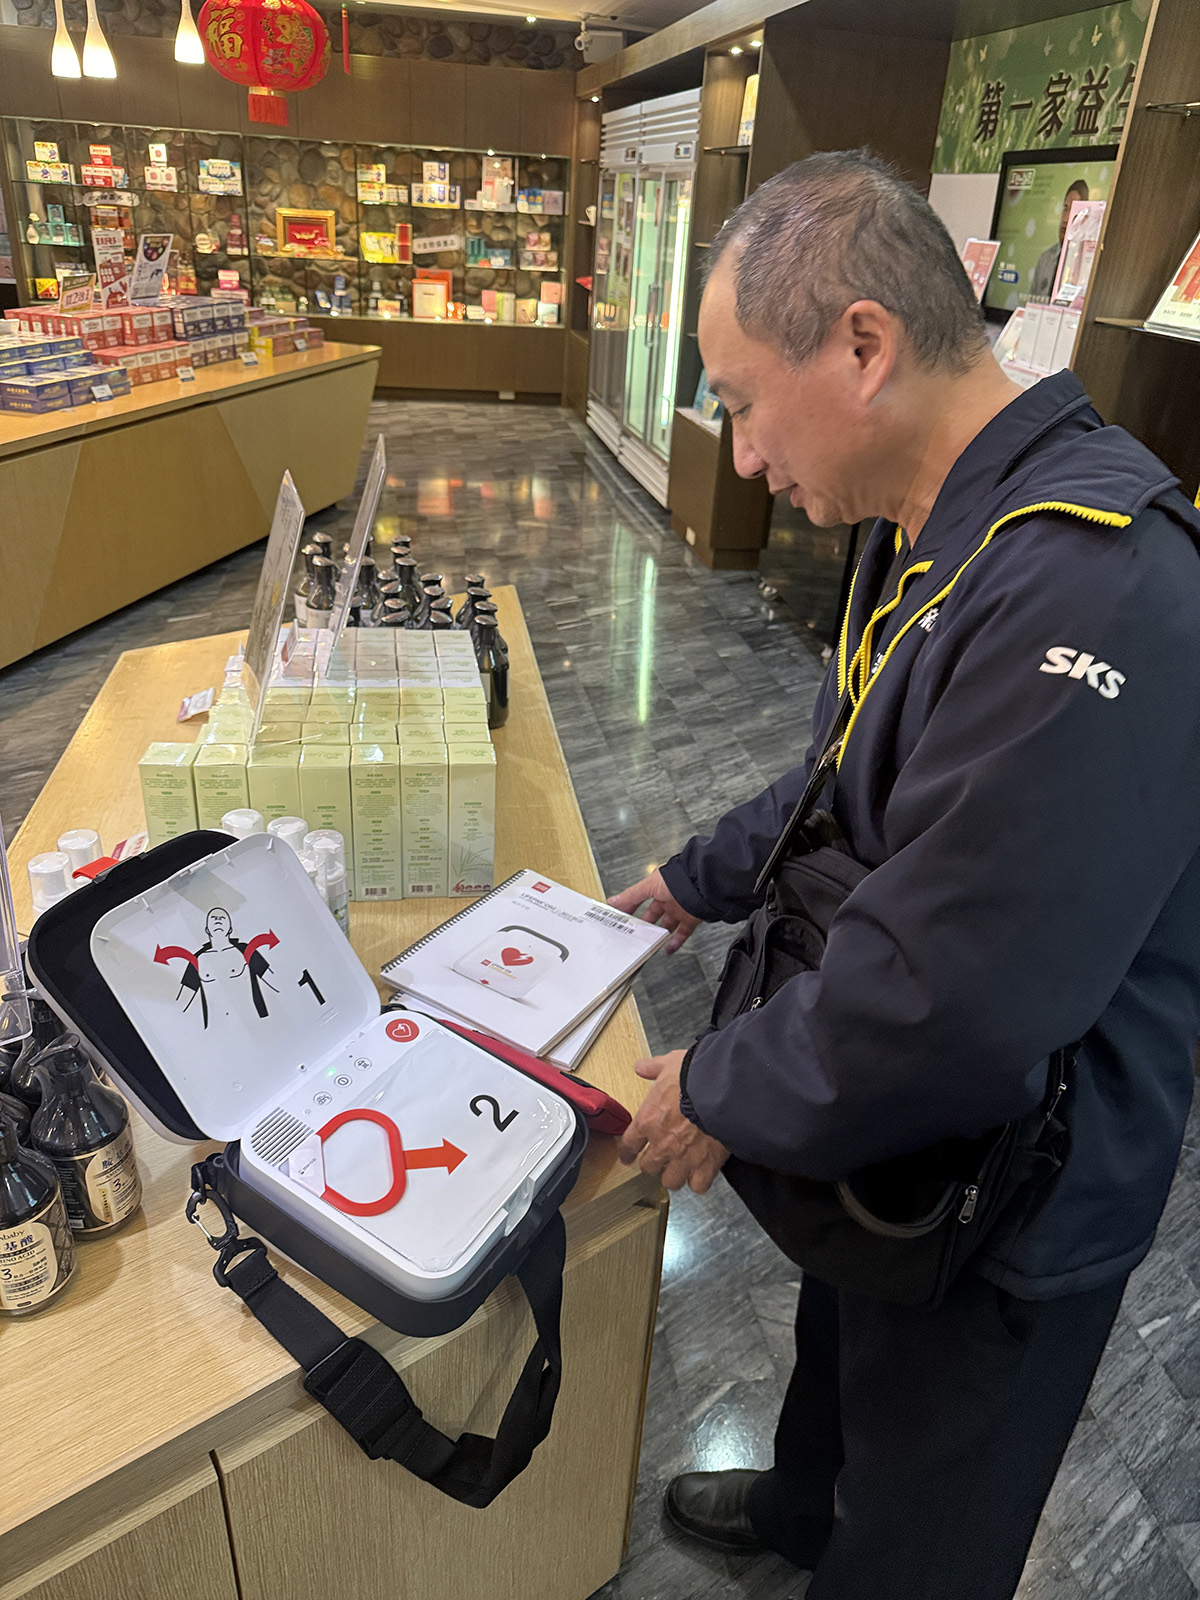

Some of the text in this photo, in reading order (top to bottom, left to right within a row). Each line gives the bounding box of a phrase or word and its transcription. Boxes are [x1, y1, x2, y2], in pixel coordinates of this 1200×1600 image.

[205, 7, 243, 60] 福
[1039, 646, 1126, 699] SKS
[297, 968, 326, 1006] 1
[469, 1094, 520, 1133] 2
[1, 1268, 12, 1281] 3
